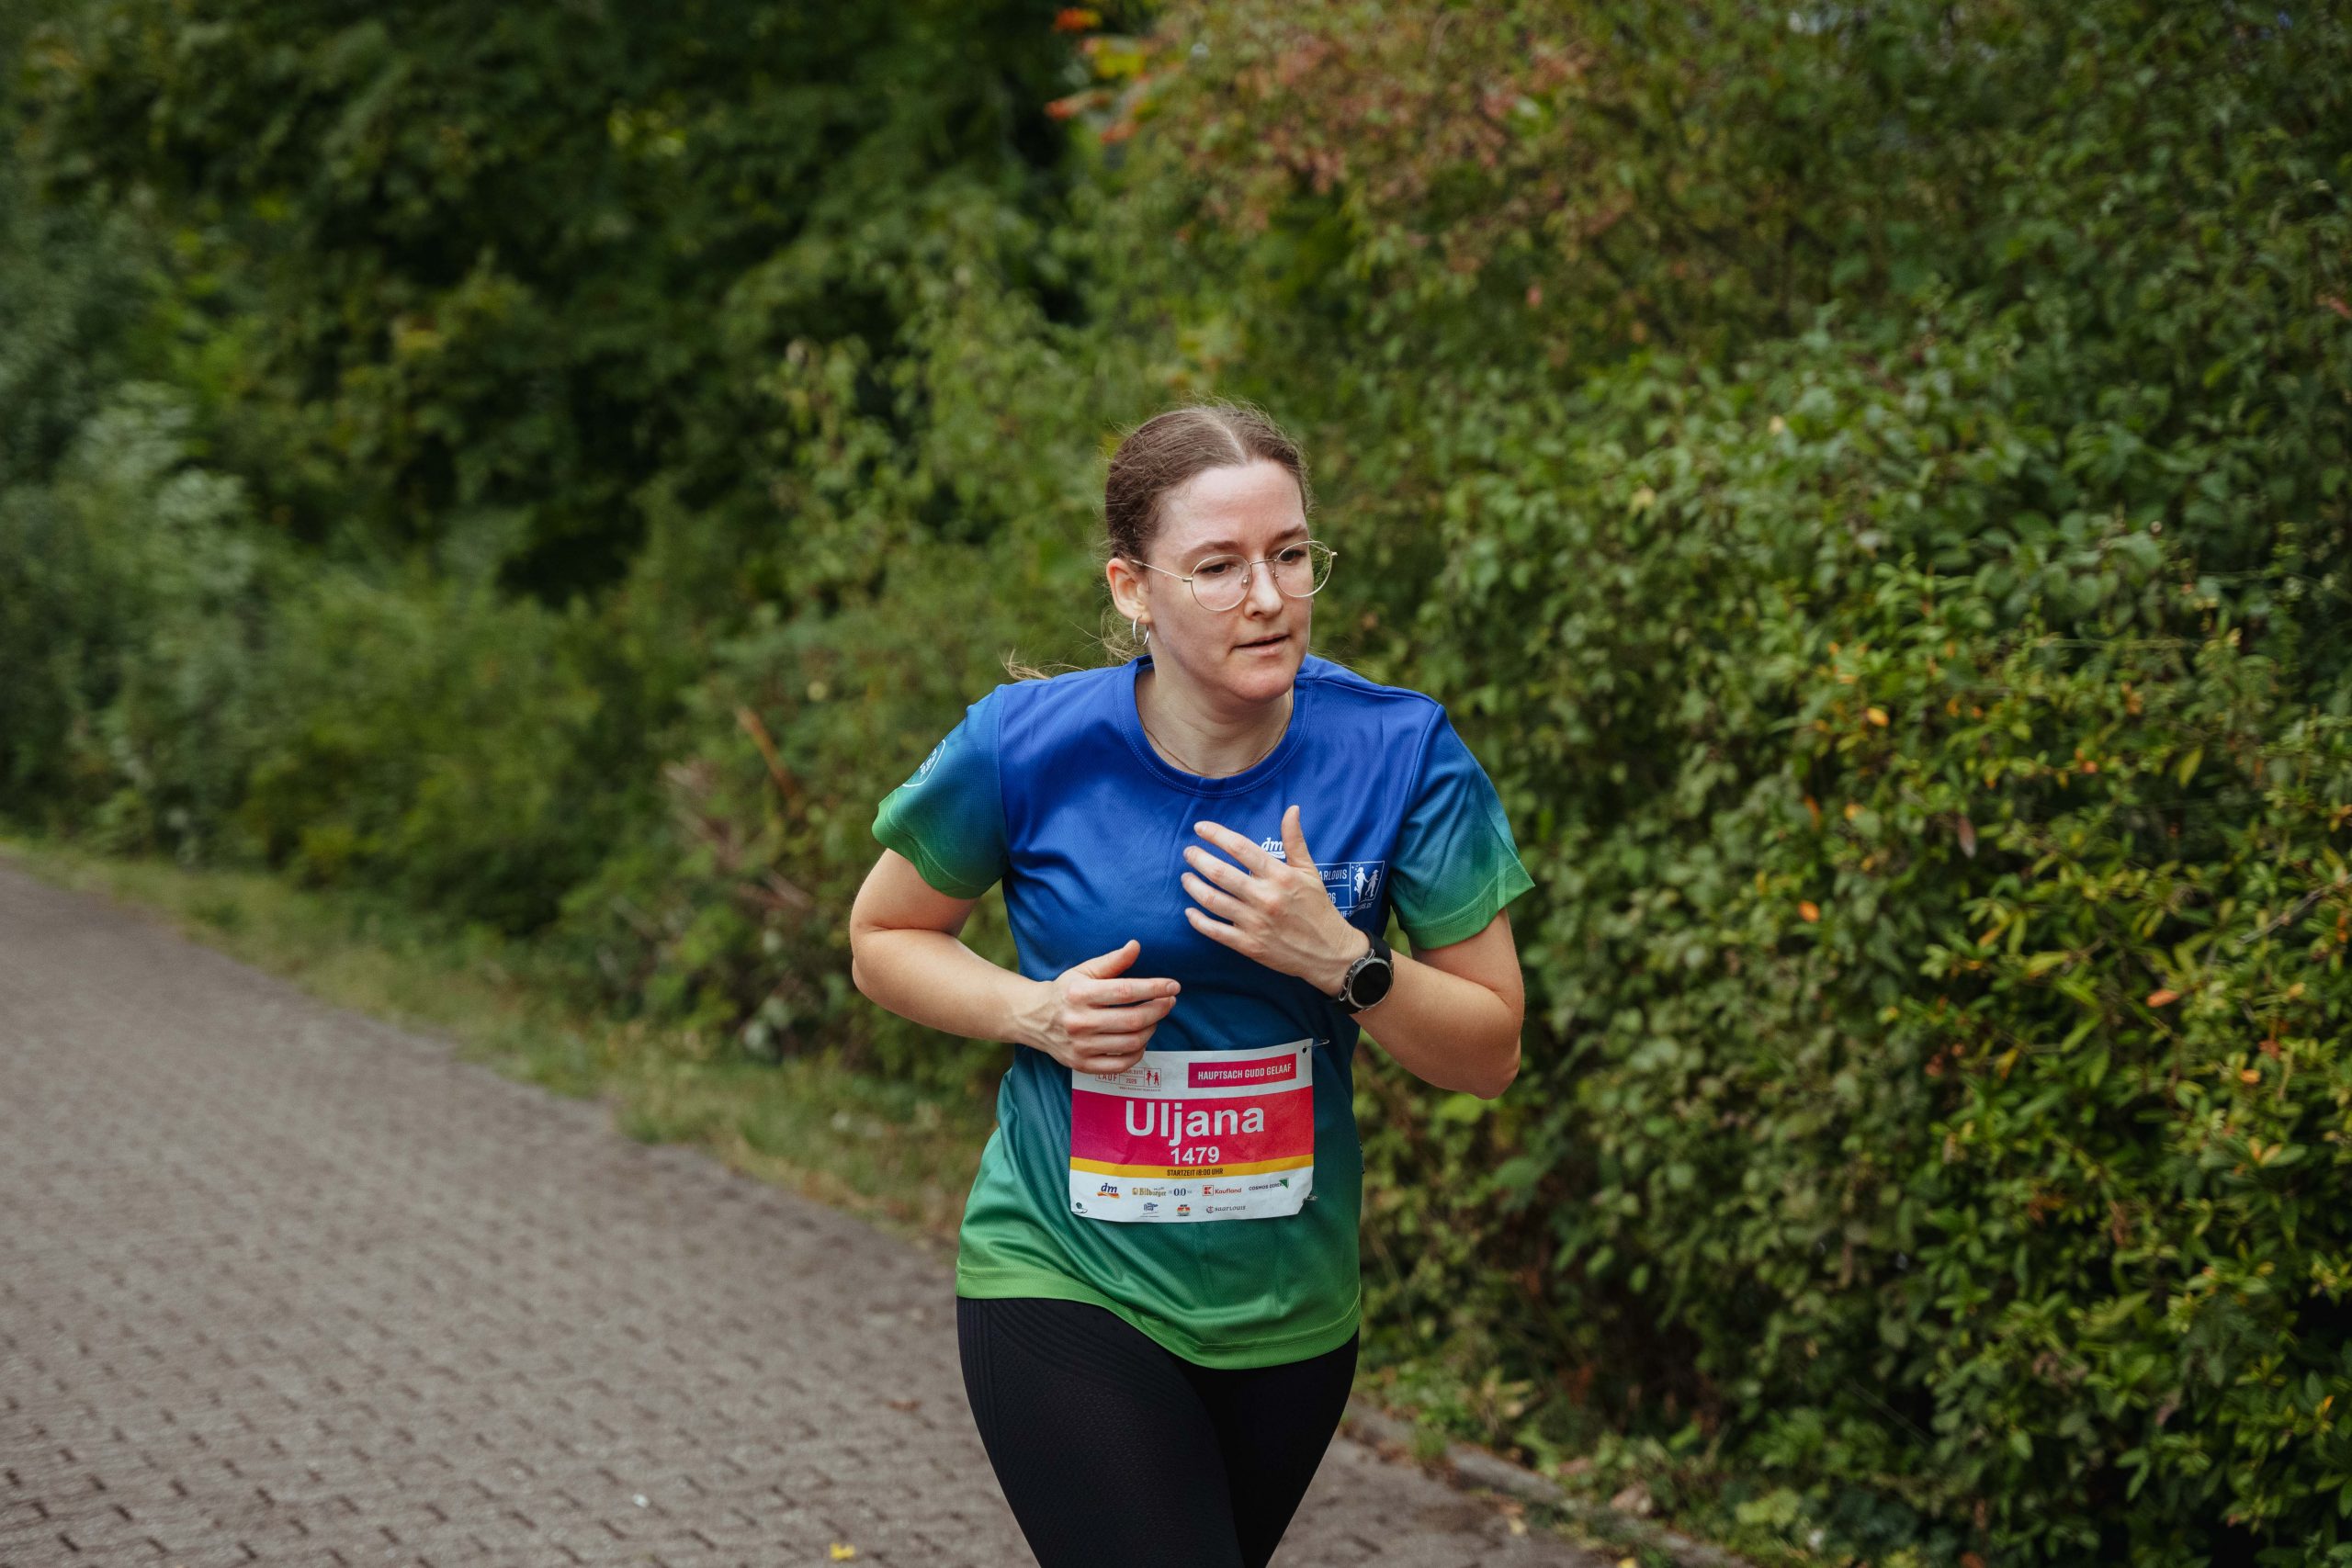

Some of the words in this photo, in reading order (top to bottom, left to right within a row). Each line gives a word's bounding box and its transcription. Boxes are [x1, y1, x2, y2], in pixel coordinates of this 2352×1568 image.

[1261, 837, 1283, 849] dm
[1198, 1071, 1243, 1080] HAUPTSACH
[1245, 1067, 1265, 1077] GUDD
[1266, 1063, 1292, 1076] GELAAF
[1125, 1100, 1264, 1146] Uljana
[1170, 1145, 1220, 1165] 1479
[1101, 1182, 1118, 1193] dm
